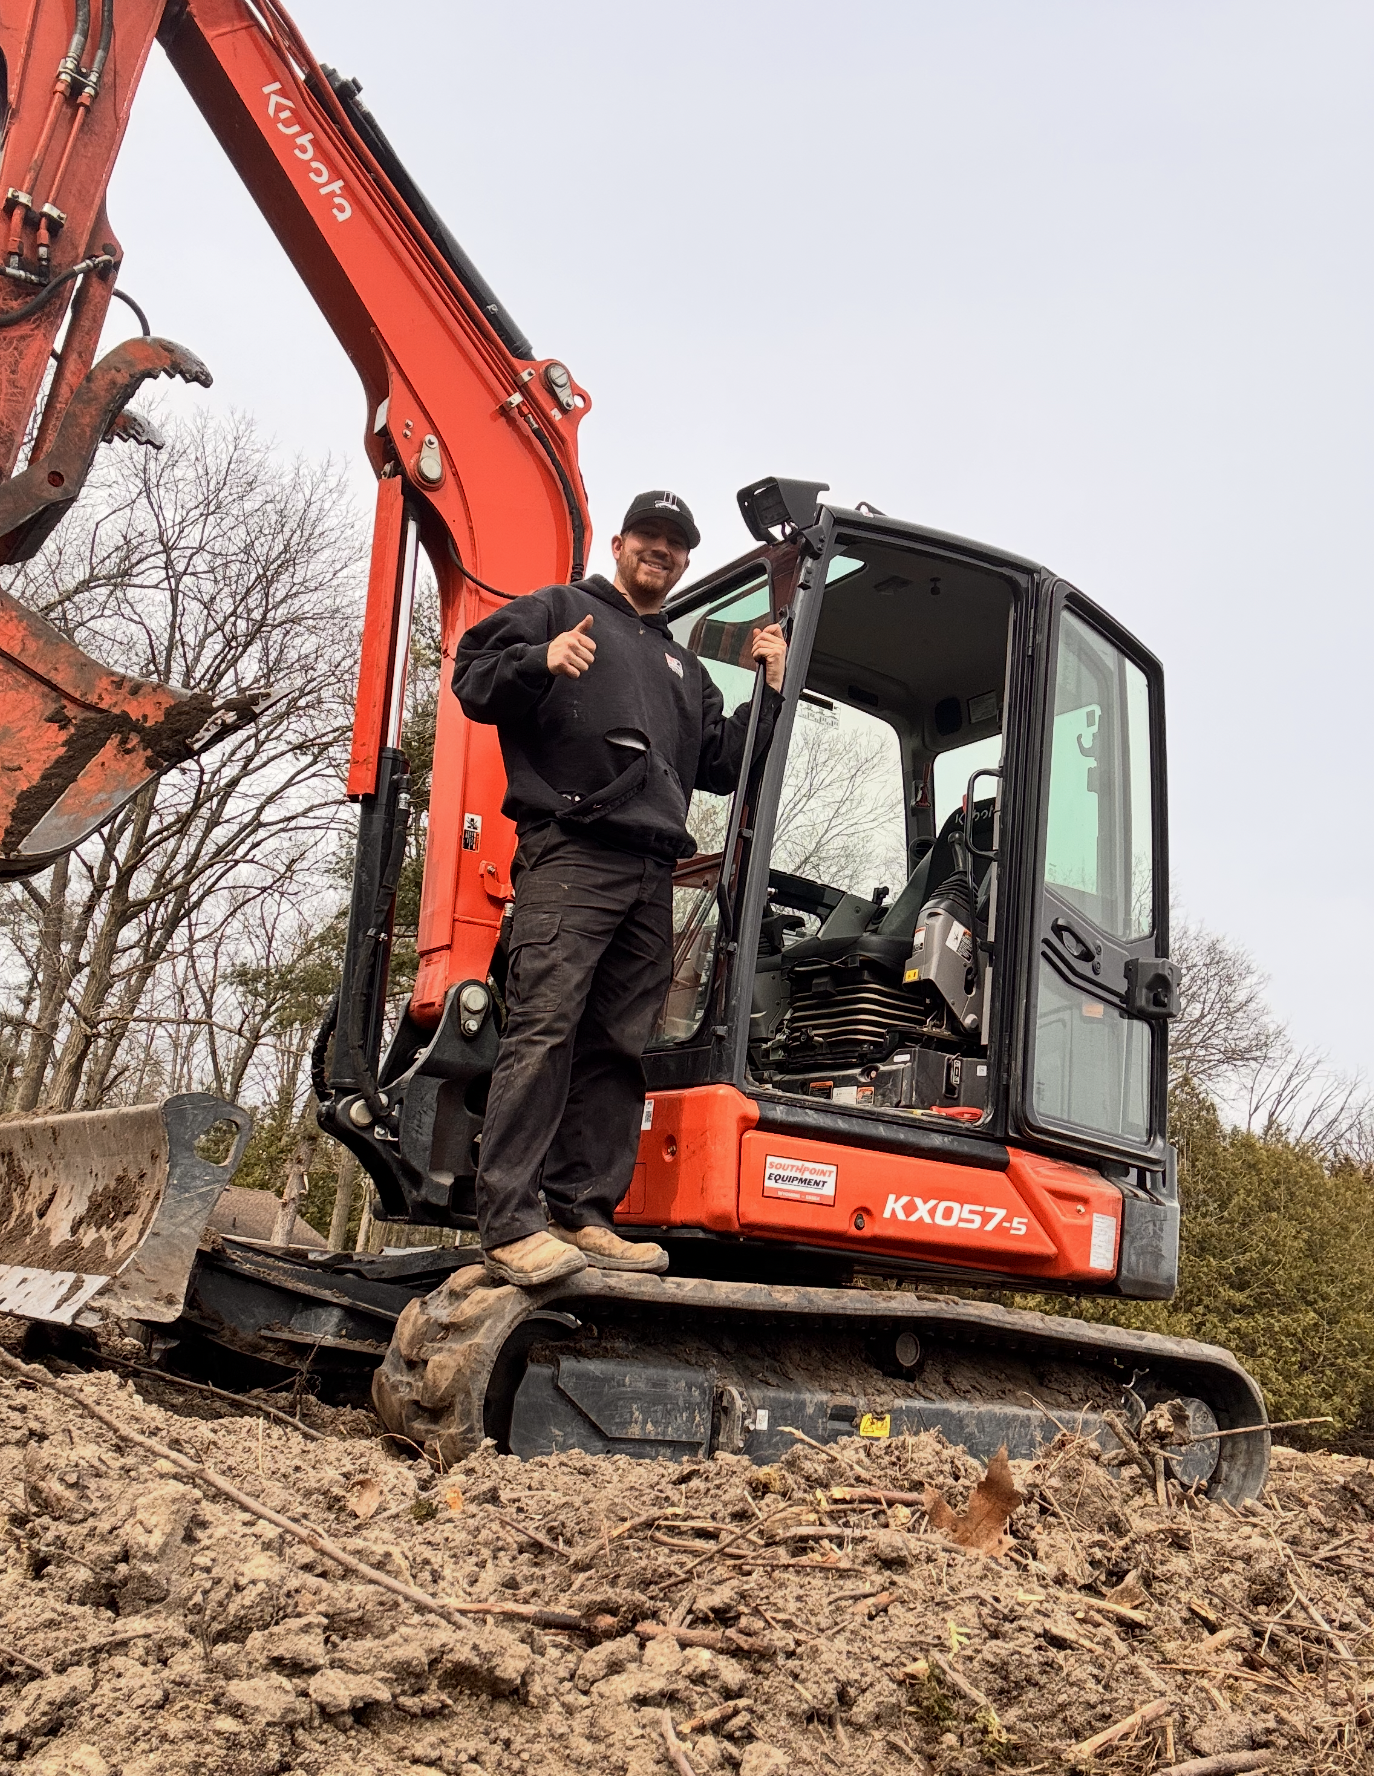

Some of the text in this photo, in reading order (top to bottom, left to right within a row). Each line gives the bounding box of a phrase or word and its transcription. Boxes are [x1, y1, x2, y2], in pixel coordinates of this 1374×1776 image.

[261, 81, 352, 222] Kubota
[955, 805, 994, 825] Kbot
[768, 1161, 834, 1178] SOUTHPOINT
[767, 1172, 828, 1188] EQUIPMENT
[882, 1193, 1029, 1236] KX057-5
